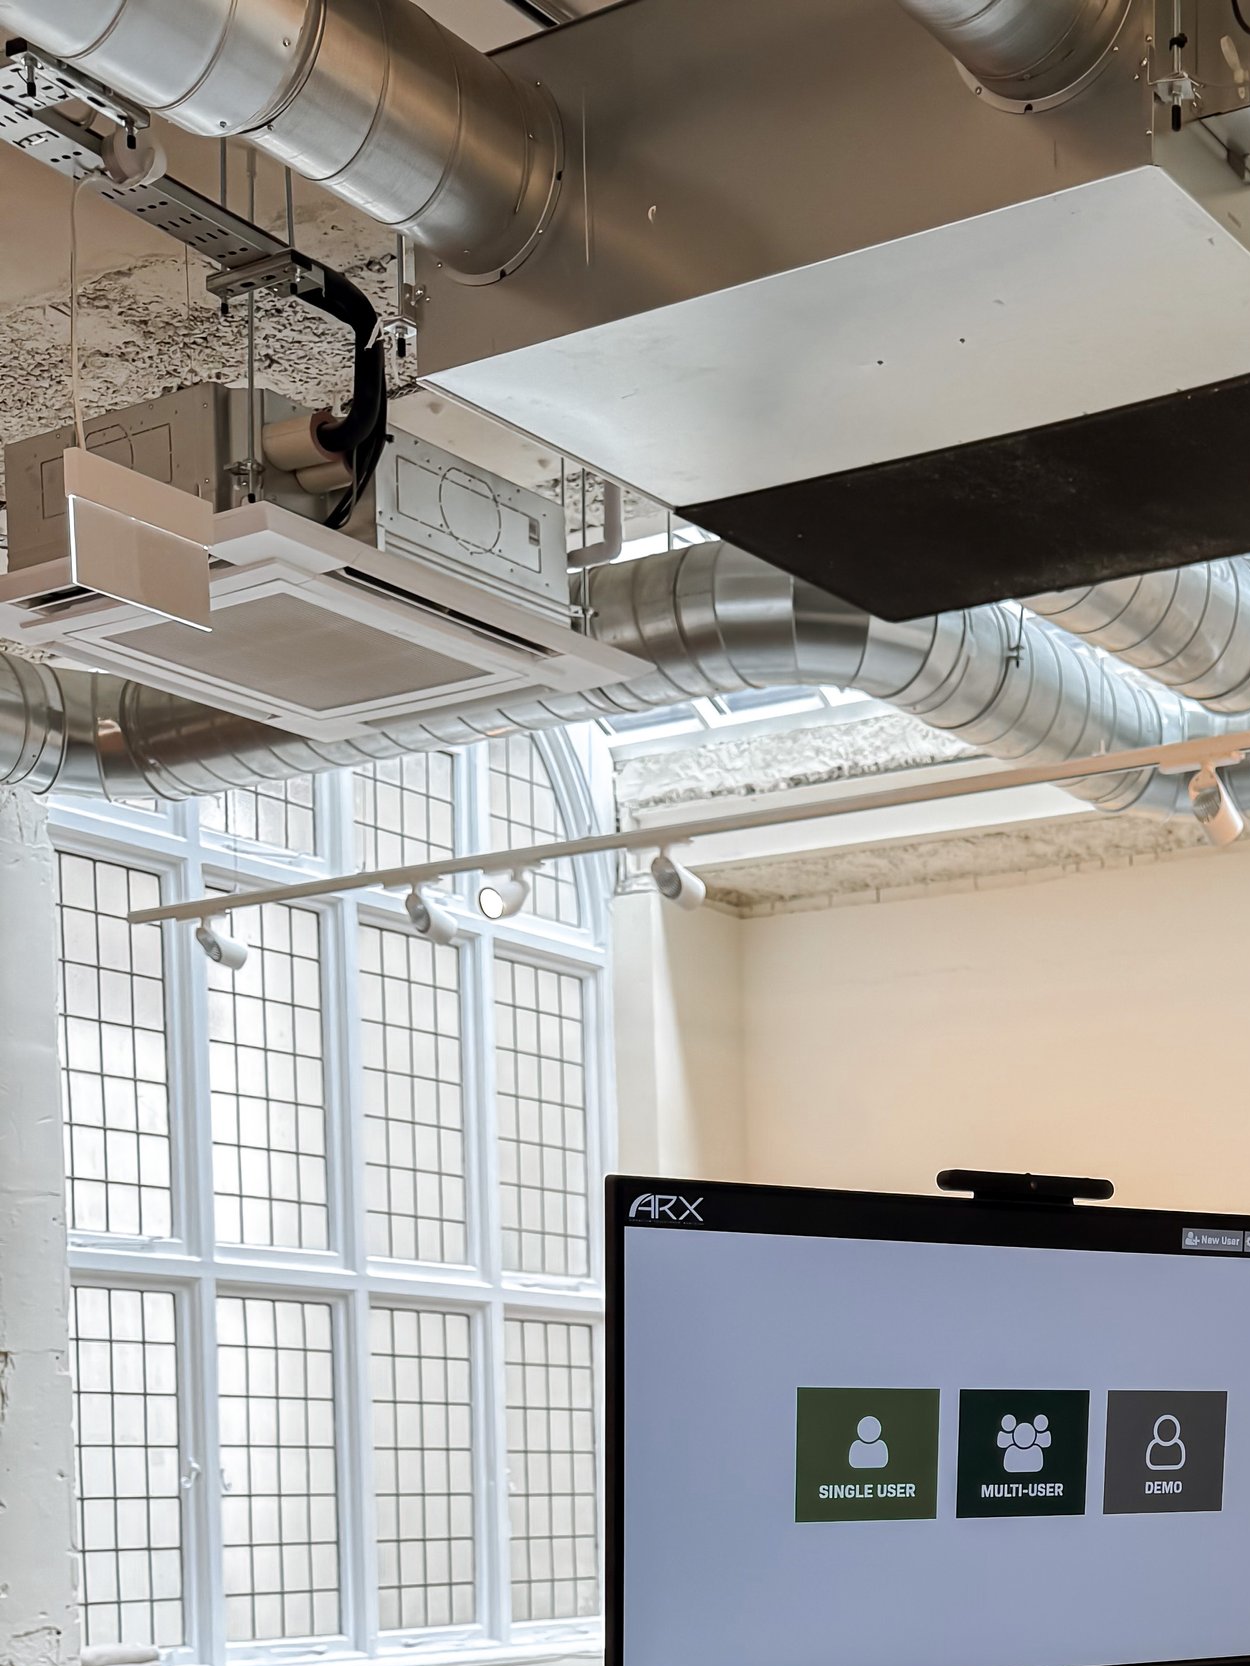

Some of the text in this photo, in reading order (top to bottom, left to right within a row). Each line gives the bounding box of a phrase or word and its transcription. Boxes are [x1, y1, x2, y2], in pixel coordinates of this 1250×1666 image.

[628, 1193, 704, 1222] ARX
[1201, 1235, 1240, 1247] New User
[818, 1484, 916, 1499] SINGLE USER
[980, 1483, 1064, 1498] MULTI-USER
[1144, 1481, 1183, 1494] DEMO
